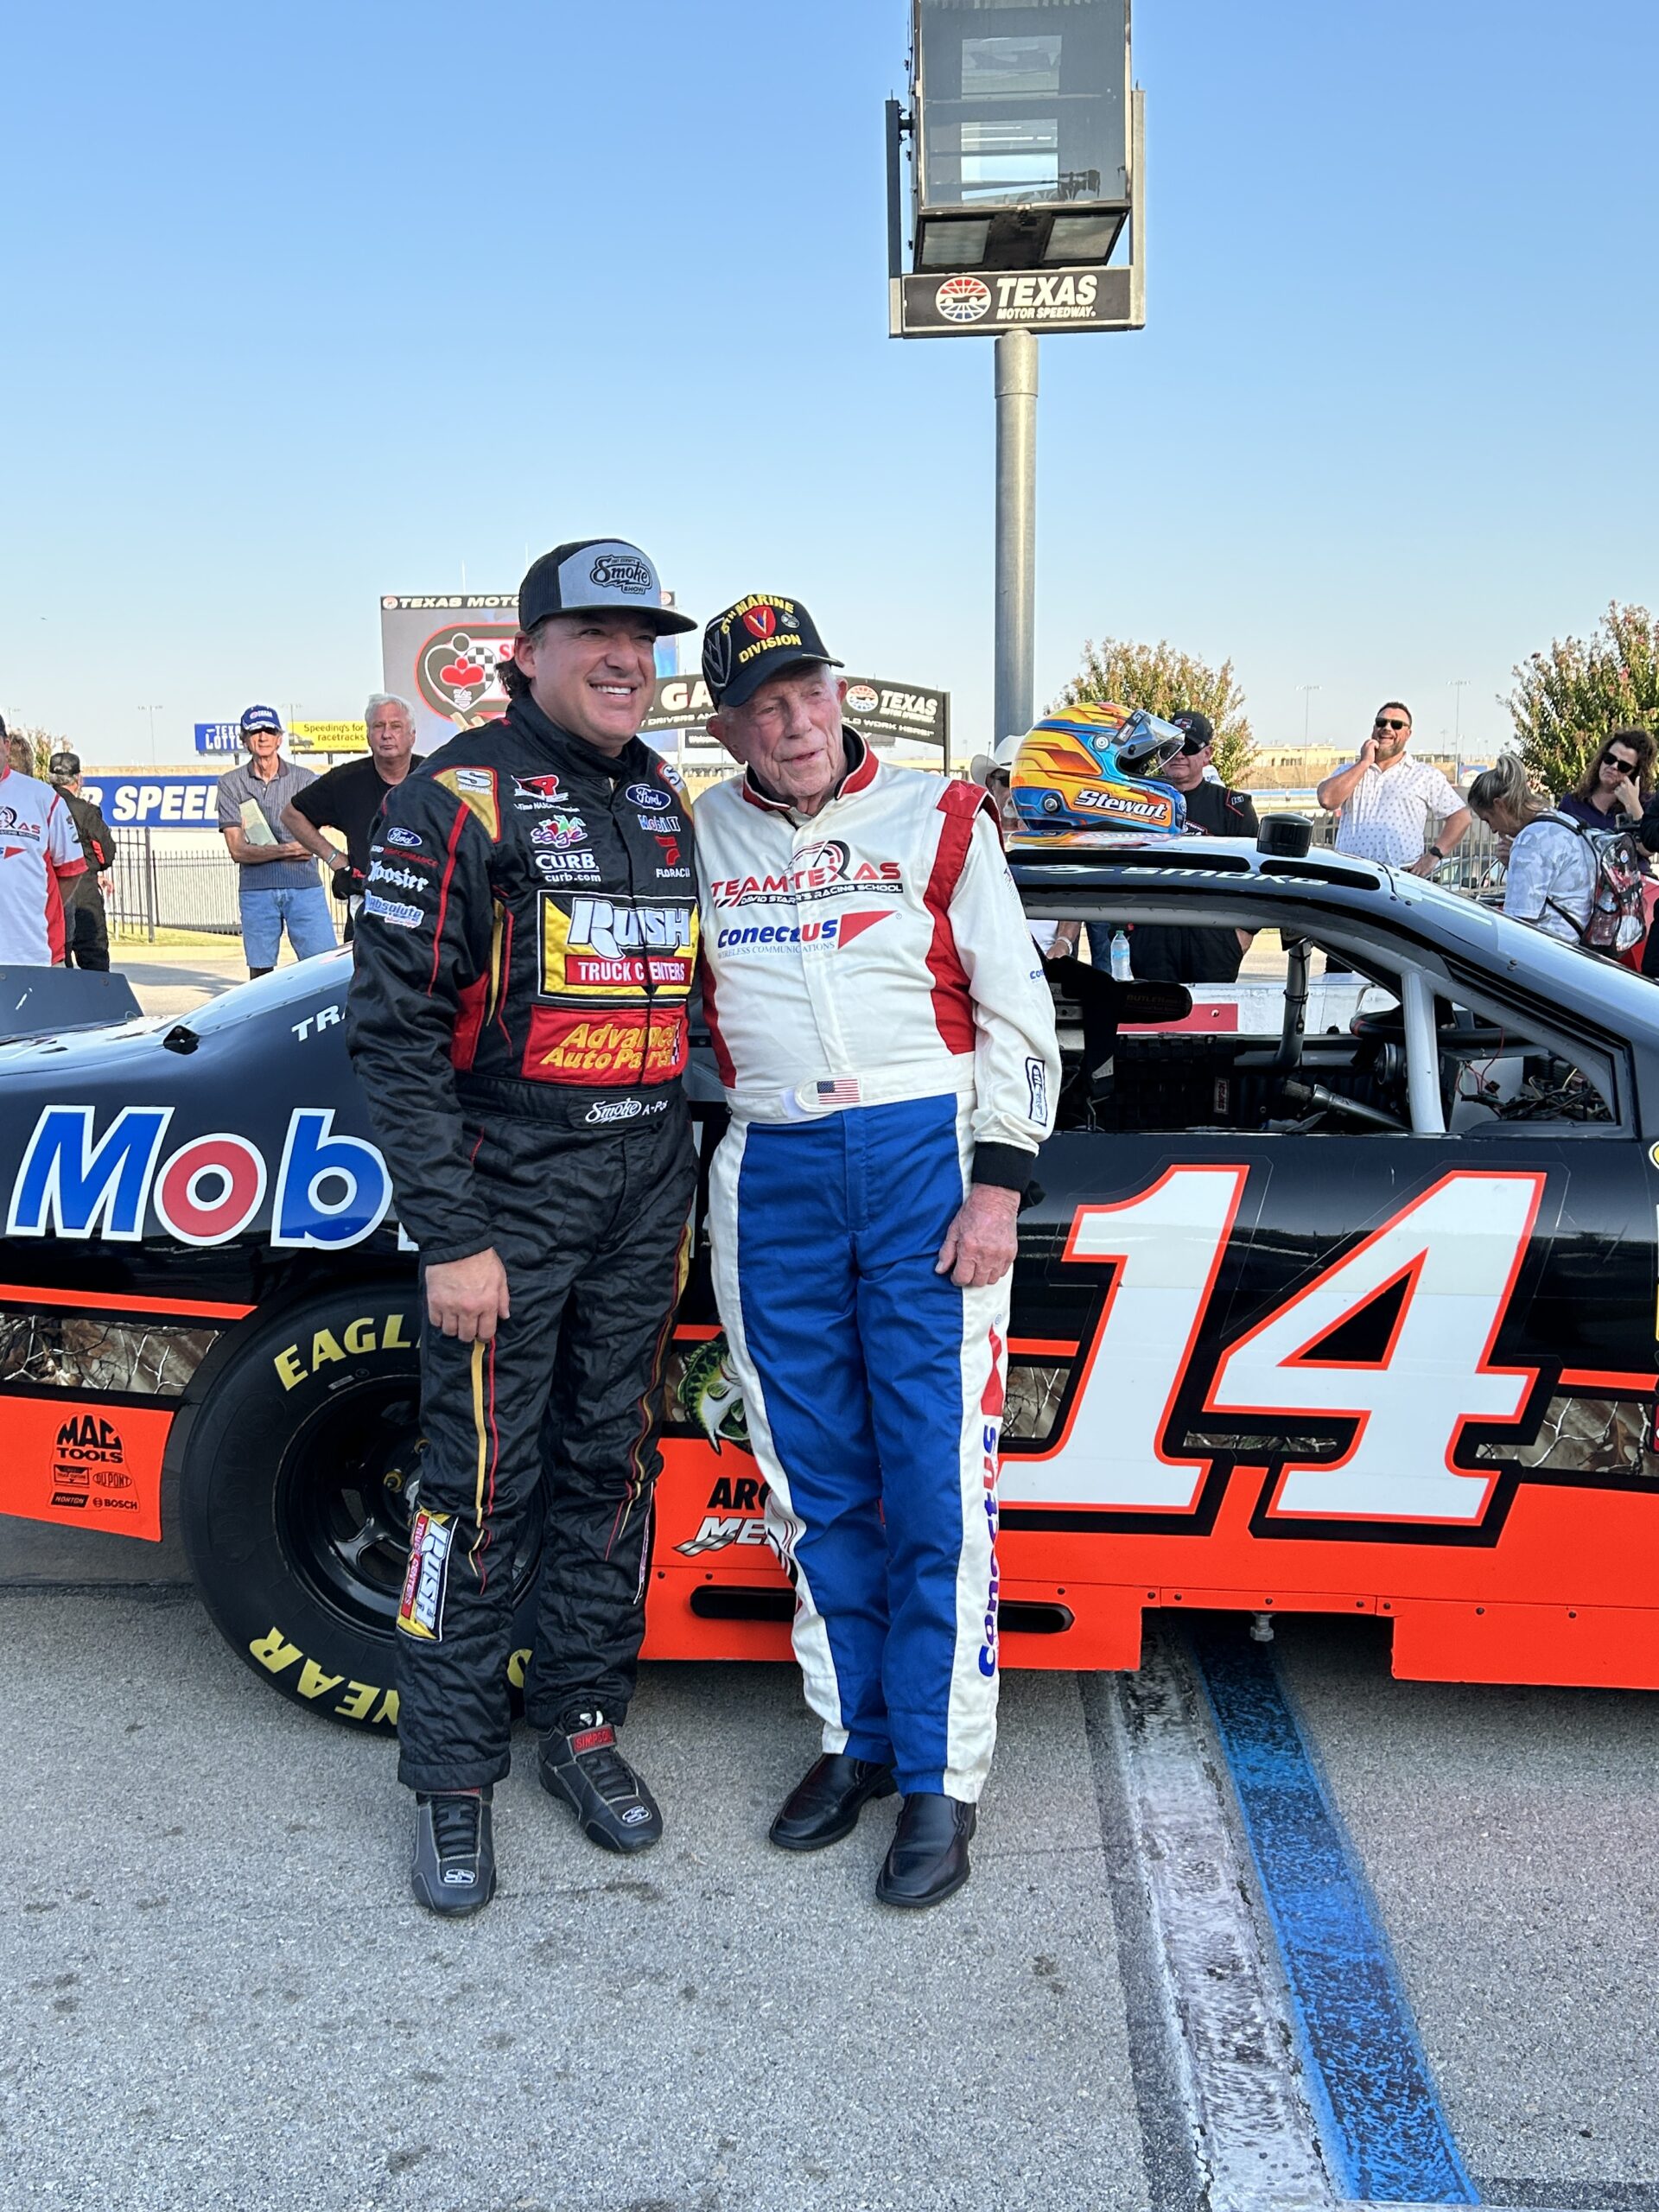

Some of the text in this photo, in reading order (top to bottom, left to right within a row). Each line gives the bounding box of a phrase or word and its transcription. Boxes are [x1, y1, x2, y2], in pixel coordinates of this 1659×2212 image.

[996, 275, 1098, 307] TEXAS
[997, 308, 1035, 320] MOTOR
[593, 557, 648, 583] Smoke
[400, 596, 520, 607] TEXAS MOTO
[735, 594, 794, 616] MARINE
[738, 634, 802, 663] DIVISION
[881, 690, 938, 716] TEXAS
[215, 726, 241, 735] TEXA
[303, 724, 350, 734] Speeding's
[648, 714, 695, 726] DRIVERS
[863, 719, 897, 730] WORK
[206, 734, 244, 749] LOTTE
[636, 787, 662, 805] Ford
[1073, 788, 1167, 820] Stewart
[390, 830, 416, 844] Ford
[531, 828, 588, 849] sage
[368, 860, 429, 892] Hoosier
[545, 872, 601, 882] curb.com
[741, 895, 767, 905] DAVID
[815, 885, 855, 899] RACING
[857, 884, 902, 893] SCHOOL
[370, 897, 422, 918] Absolute
[568, 897, 691, 960] RUSH
[717, 942, 835, 959] WIRELESS COMMUNICATIONS
[578, 962, 684, 982] TRUCK CENTERS
[291, 1005, 346, 1042] TR
[540, 1046, 611, 1070] Auto
[585, 1097, 641, 1124] Smoke
[6, 1104, 419, 1251] Mob
[274, 1314, 422, 1391] EAGL
[998, 1164, 1547, 1527] 14
[57, 1414, 123, 1451] MAC
[57, 1447, 124, 1463] TOOLS
[104, 1498, 137, 1510] BOSCH
[696, 1516, 771, 1545] ME
[404, 1559, 420, 1605] CENTERS
[415, 1518, 450, 1630] RUSH
